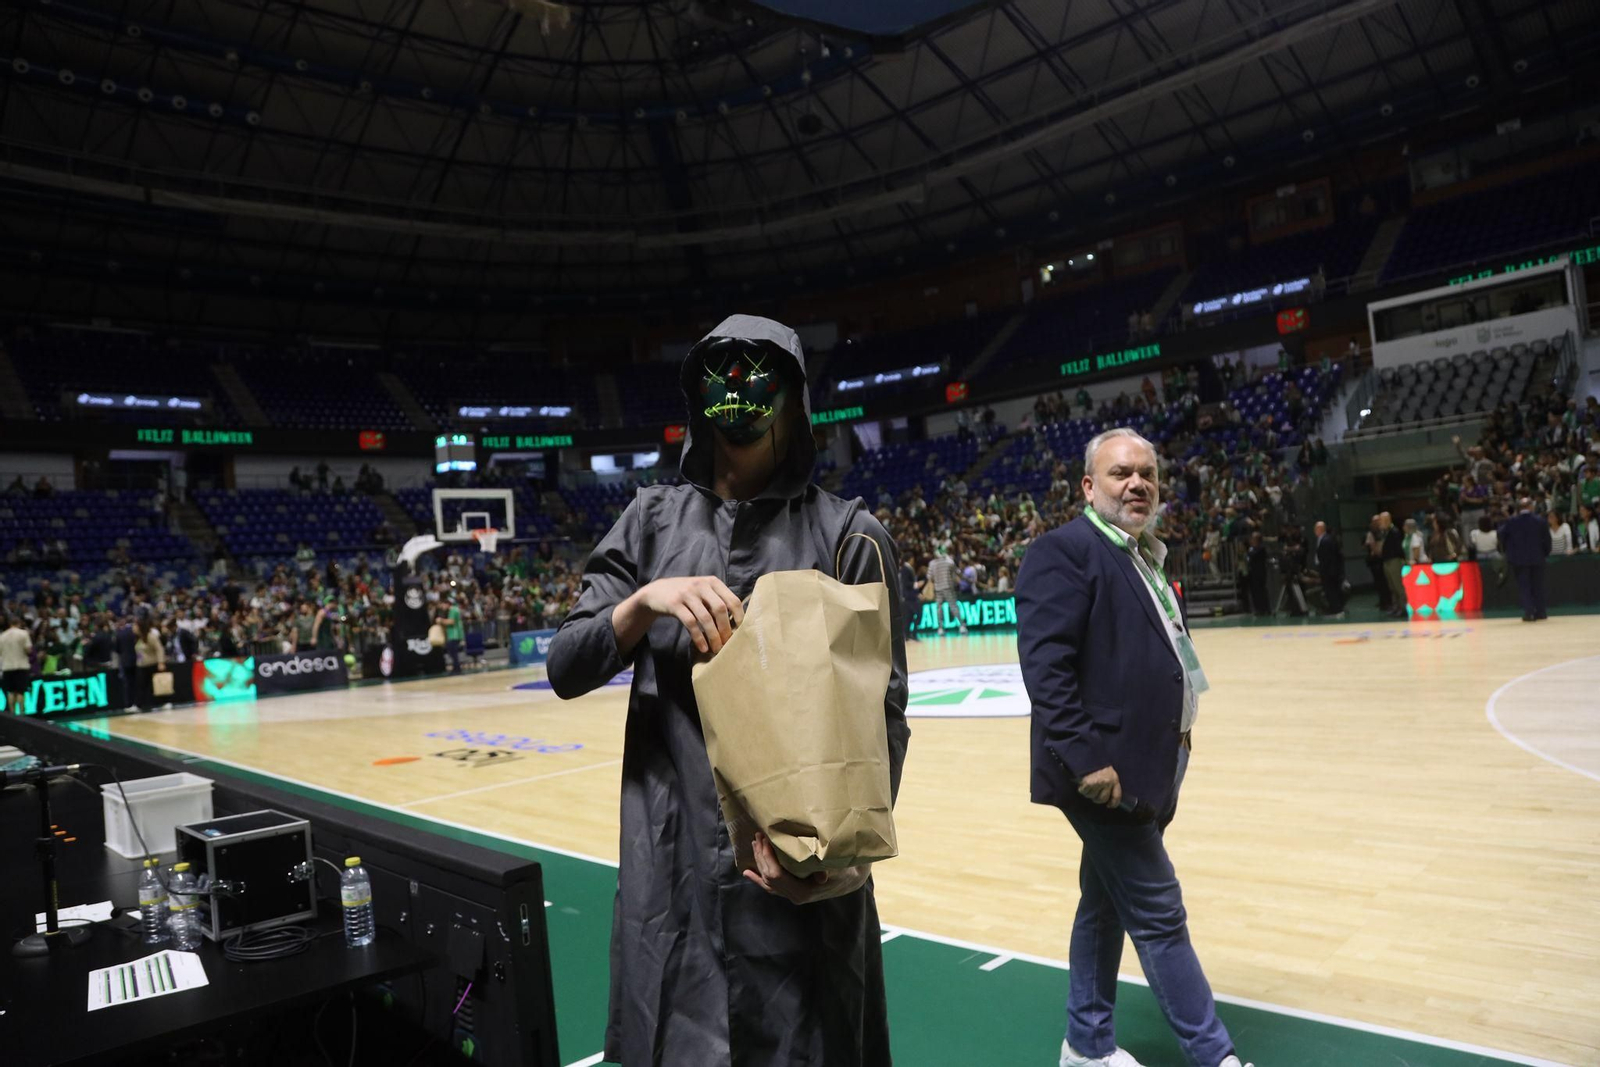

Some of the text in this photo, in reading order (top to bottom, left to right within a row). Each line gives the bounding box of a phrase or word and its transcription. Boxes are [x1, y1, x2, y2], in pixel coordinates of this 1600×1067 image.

[909, 597, 1018, 631] ALLOWEEN
[258, 655, 339, 677] endesa
[0, 673, 109, 716] WEEN
